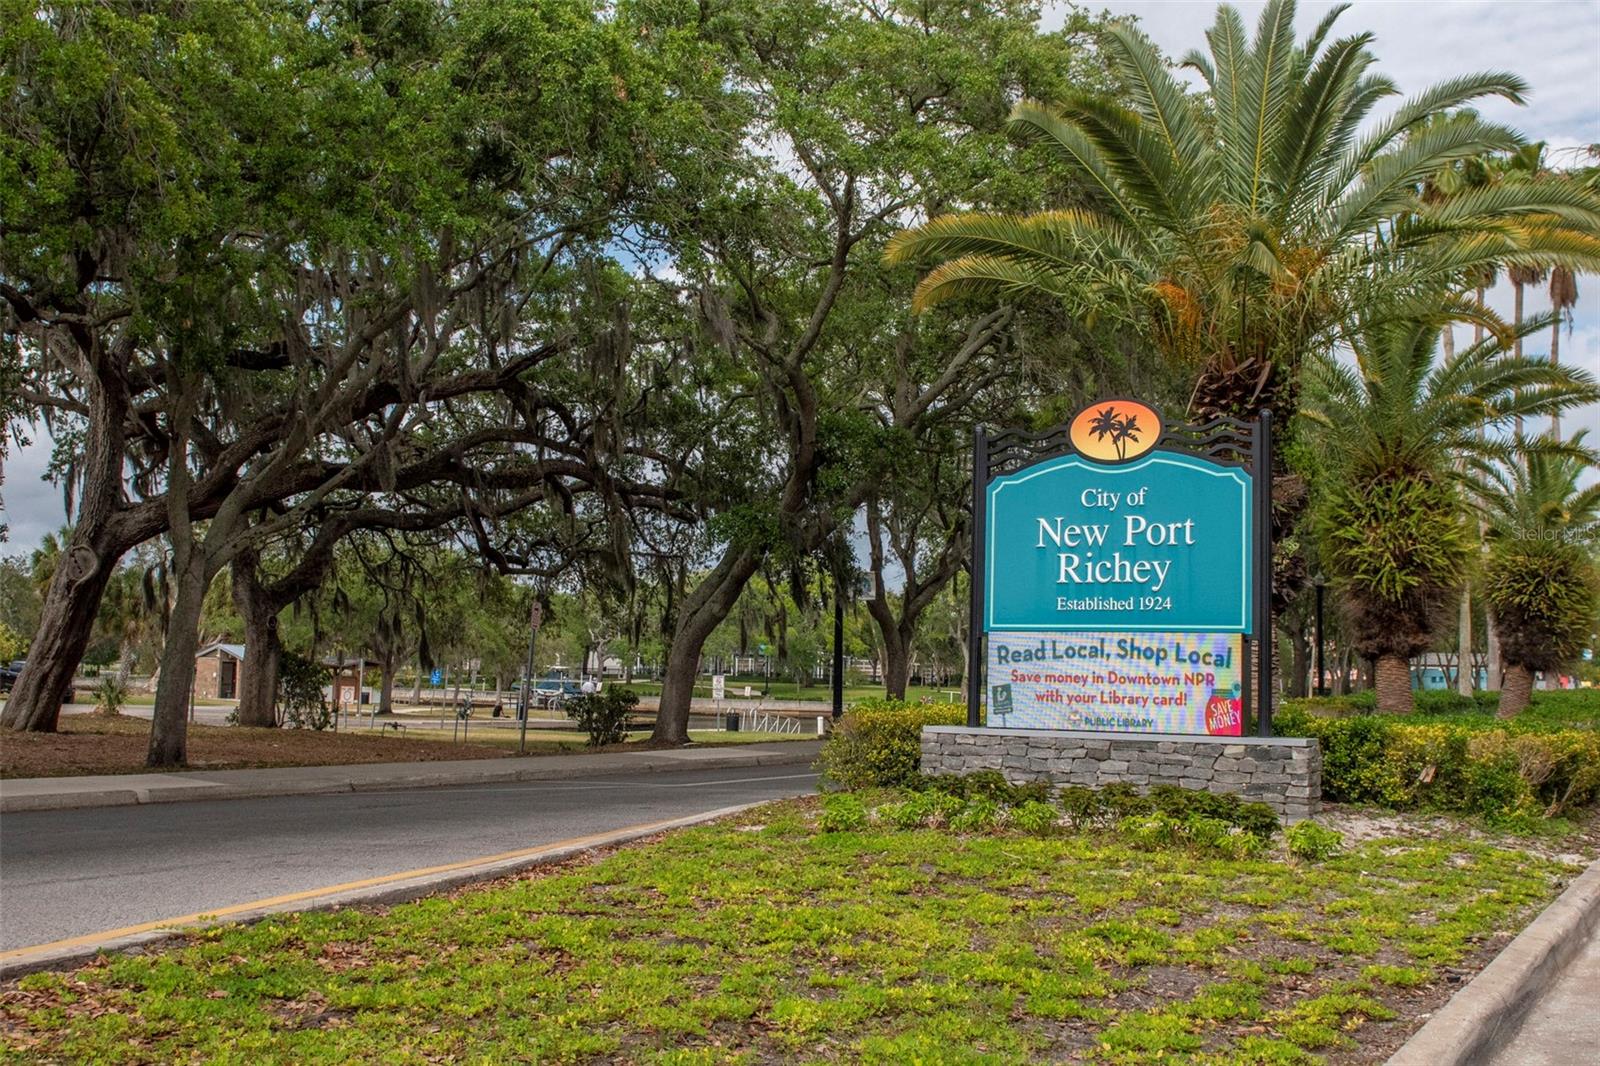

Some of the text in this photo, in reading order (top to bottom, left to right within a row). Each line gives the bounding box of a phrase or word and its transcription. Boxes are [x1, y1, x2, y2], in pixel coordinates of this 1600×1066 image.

[1081, 487, 1148, 511] City of
[1036, 515, 1196, 548] New Port
[1056, 553, 1172, 591] Richey
[1056, 597, 1172, 611] Established 1924
[997, 638, 1233, 669] Read Local, Shop Local
[1010, 669, 1215, 687] Save money in Downtown NPR
[1035, 688, 1188, 708] with your Library card!
[1211, 699, 1233, 717] SAVE
[1084, 716, 1154, 728] PUBLIC LIBRARY
[1209, 710, 1241, 731] MONEY
